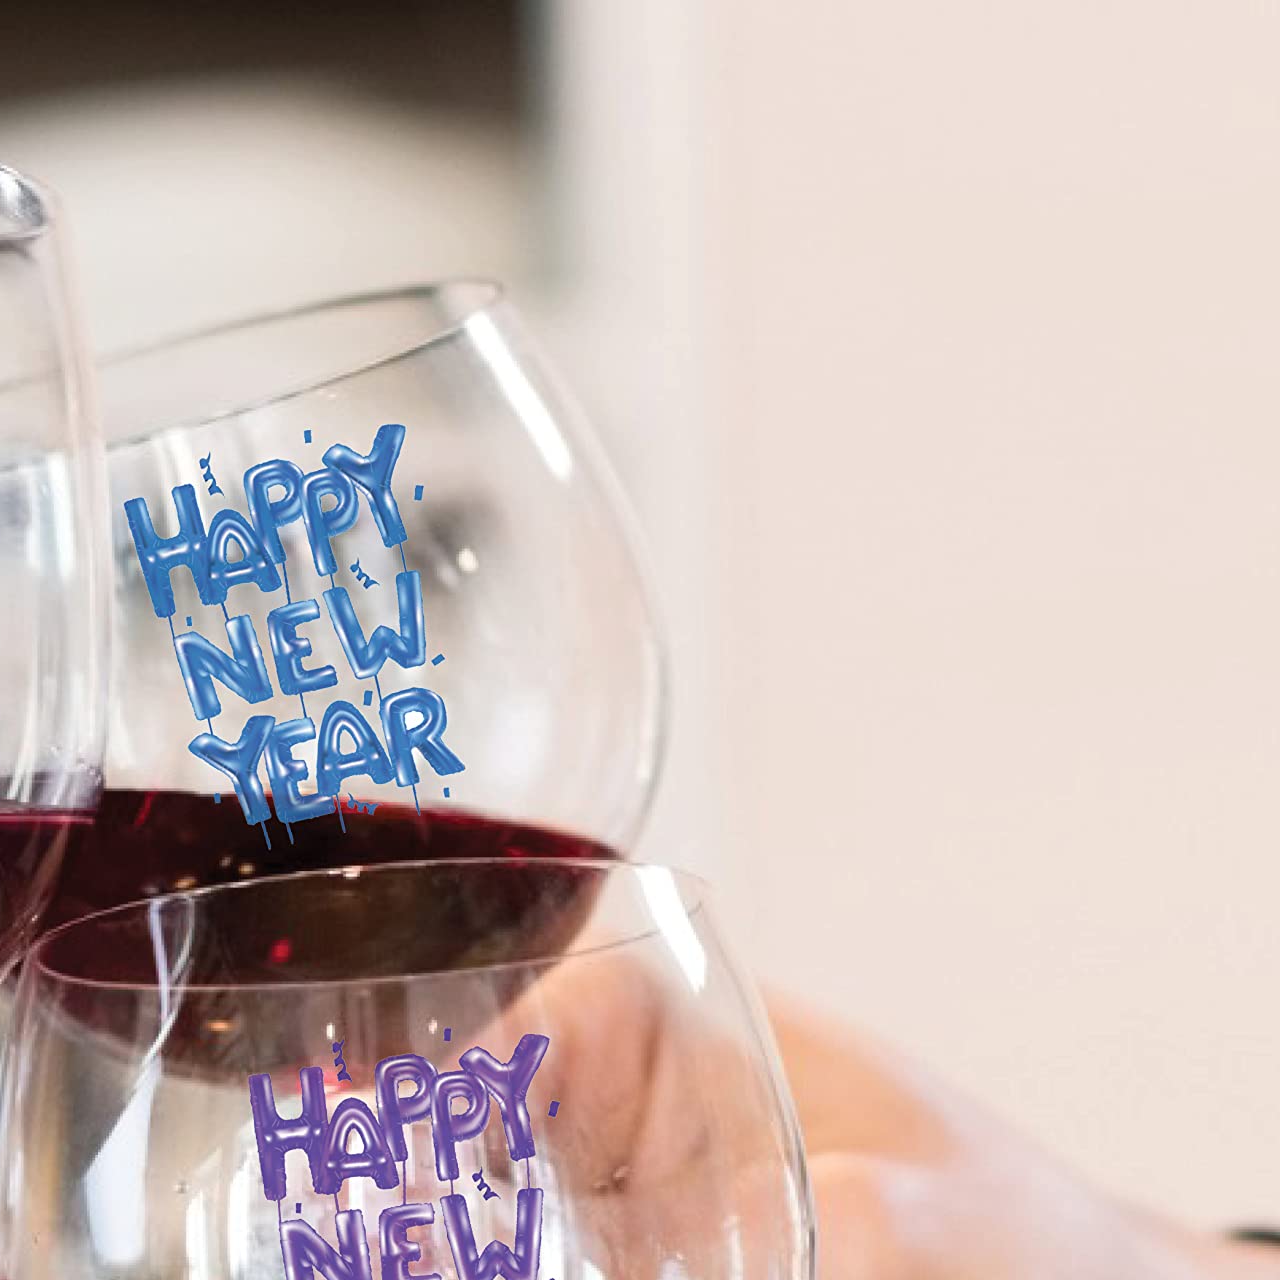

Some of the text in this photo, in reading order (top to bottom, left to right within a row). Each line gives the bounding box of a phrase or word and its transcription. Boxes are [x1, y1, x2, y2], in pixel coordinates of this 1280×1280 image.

[124, 424, 405, 618] HAPPY
[174, 571, 426, 720] NEW
[188, 687, 465, 826] YEAR
[249, 1034, 550, 1200] HAPPY
